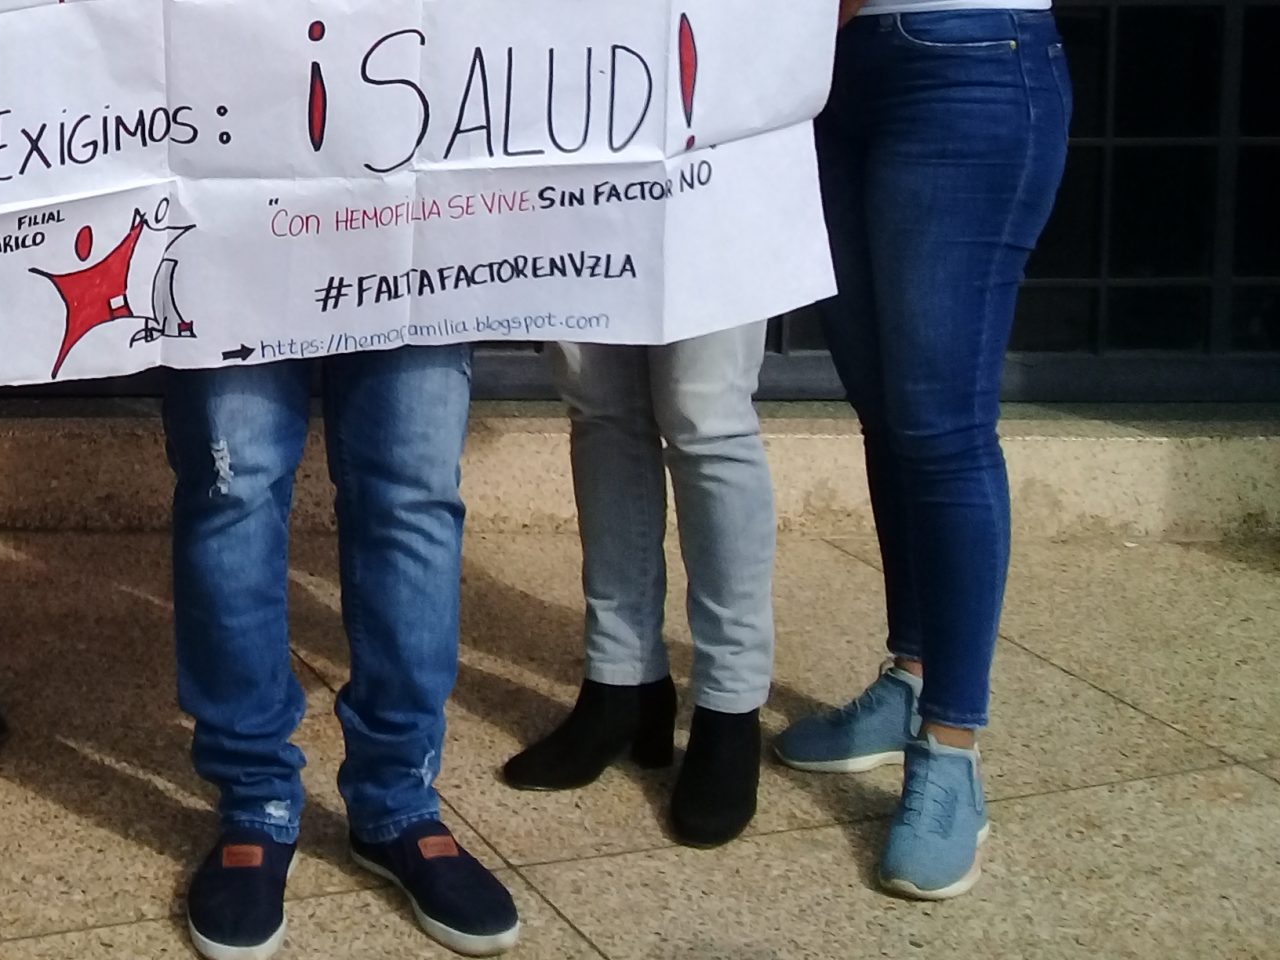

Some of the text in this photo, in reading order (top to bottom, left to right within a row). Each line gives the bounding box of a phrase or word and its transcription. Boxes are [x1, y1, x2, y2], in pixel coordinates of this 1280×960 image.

[17, 209, 66, 231] FILIAL
[335, 196, 441, 233] HEMOFILIA
[448, 193, 476, 220] SE
[538, 186, 585, 210] SIN
[593, 181, 673, 206] FACTOR
[679, 160, 713, 193] NO
